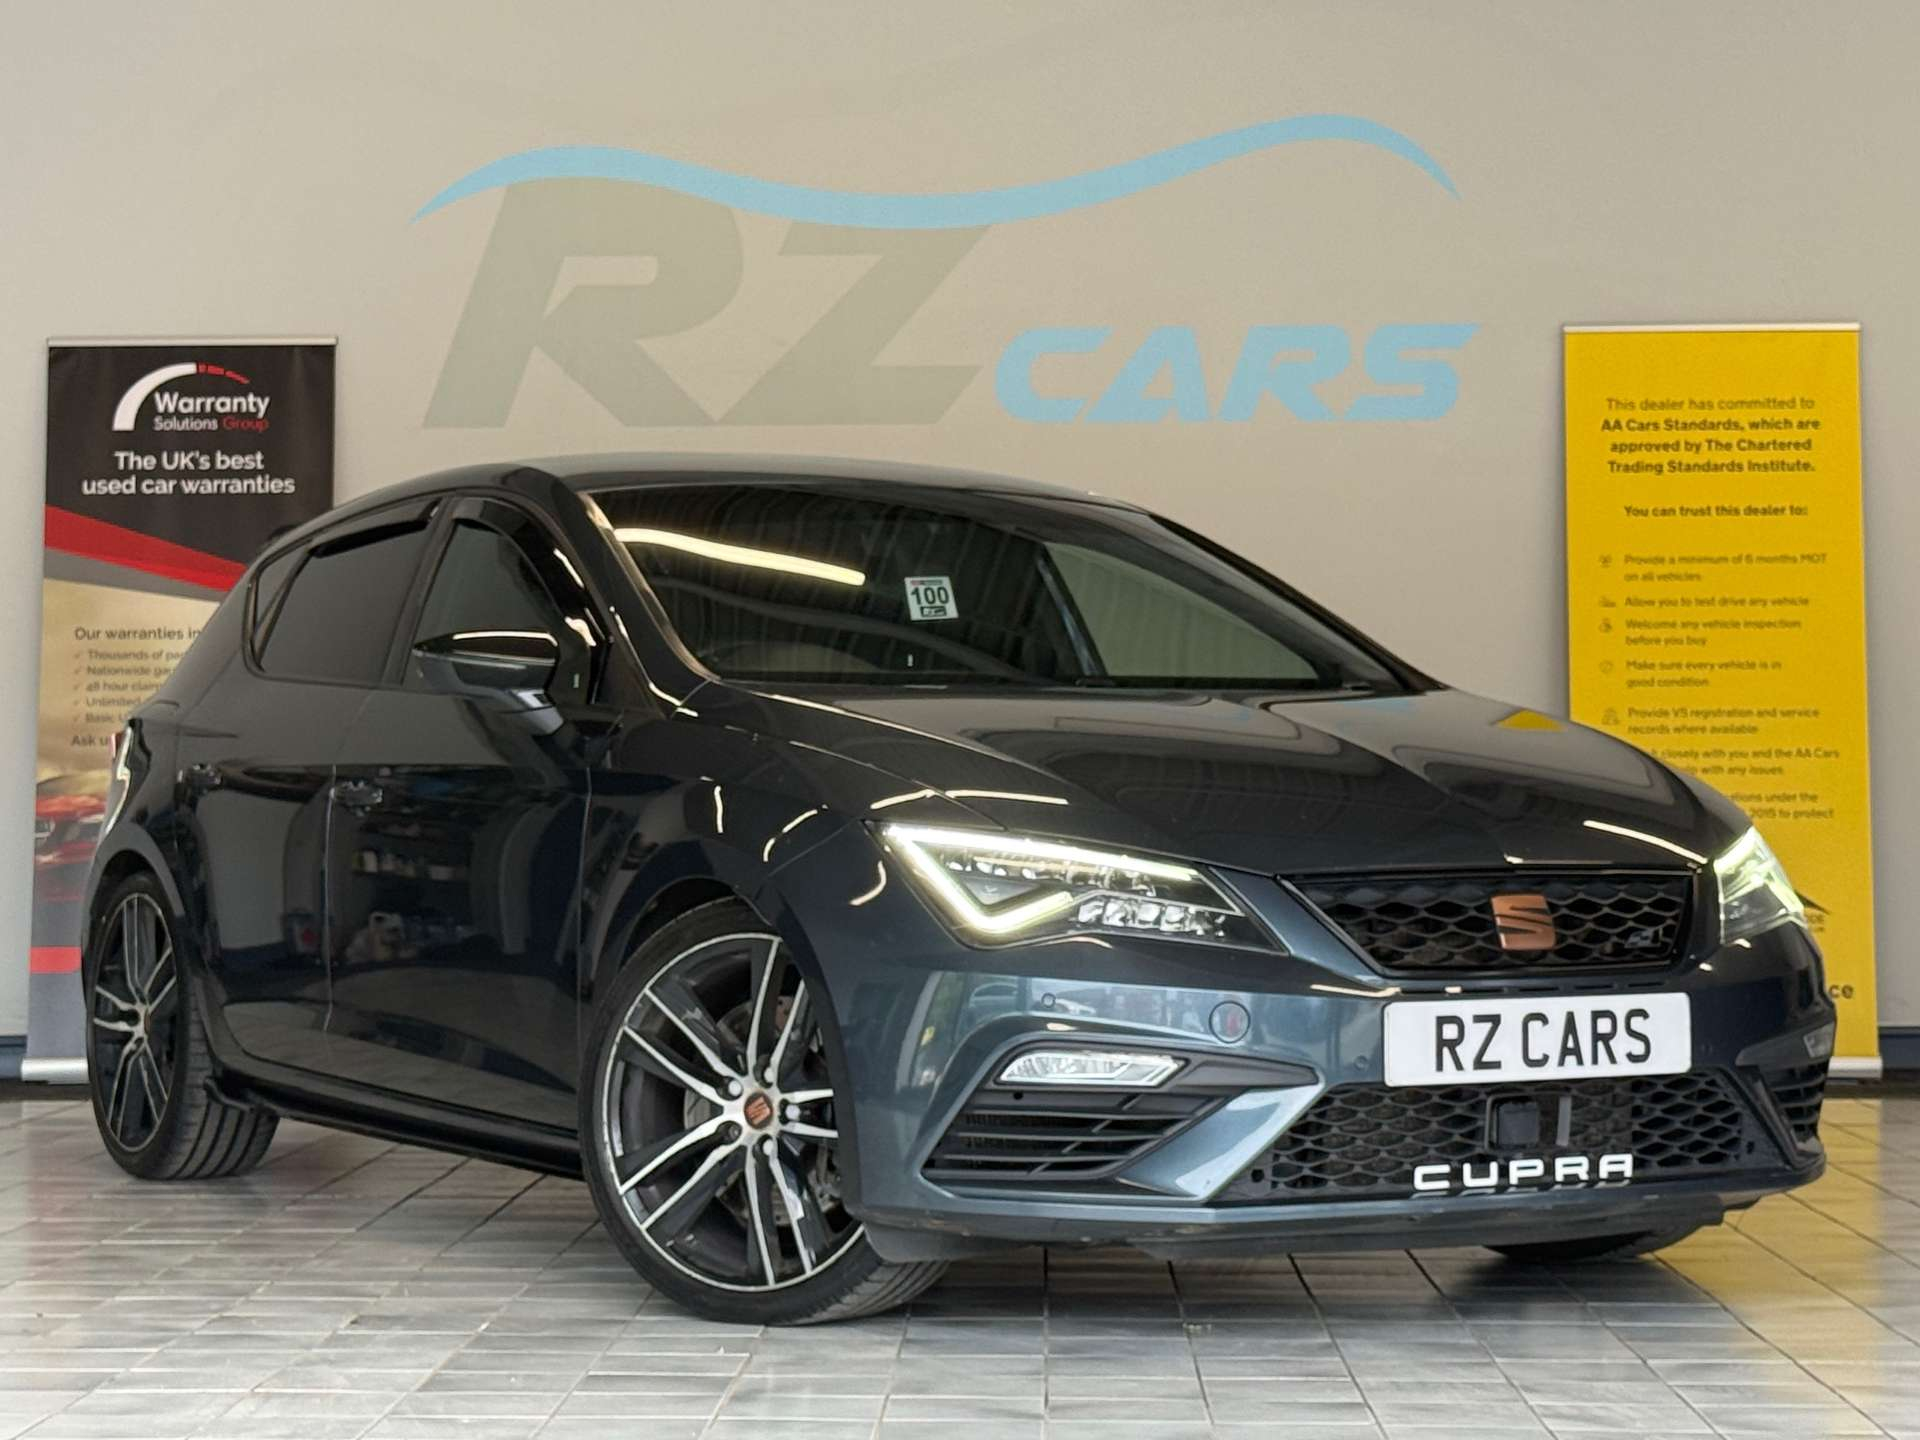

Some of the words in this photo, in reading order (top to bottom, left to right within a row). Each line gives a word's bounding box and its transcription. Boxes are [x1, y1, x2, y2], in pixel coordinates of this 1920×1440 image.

[421, 177, 994, 429] RZ
[994, 322, 1481, 424] CARS
[153, 391, 271, 418] Warranty
[1606, 398, 1636, 411] This
[1640, 398, 1684, 411] dealer
[1688, 398, 1714, 410] has
[1717, 398, 1796, 410] committed
[1800, 398, 1815, 410] to
[153, 415, 218, 431] Solutions
[222, 416, 269, 432] Group
[1601, 419, 1623, 432] AA
[1625, 418, 1660, 431] Cars
[1664, 418, 1744, 431] Standards,
[1747, 418, 1793, 430] which
[1796, 419, 1821, 430] are
[1610, 440, 1679, 453] approved
[1684, 440, 1701, 454] by
[1704, 439, 1733, 451] The
[1736, 439, 1812, 451] Chartered
[114, 451, 157, 470] The
[161, 451, 211, 470] UK's
[215, 450, 264, 470] best
[1607, 460, 1663, 475] Trading
[1667, 459, 1744, 473] Standards
[1747, 459, 1815, 472] Institute.
[82, 474, 136, 495] used
[141, 478, 177, 495] car
[180, 474, 295, 495] warranties
[1624, 505, 1649, 517] You
[1651, 507, 1677, 517] can
[1679, 505, 1711, 516] trust
[1715, 505, 1740, 516] this
[1743, 504, 1787, 516] dealer
[1789, 505, 1808, 516] to:
[1624, 554, 1665, 565] Provide
[1756, 554, 1797, 564] months
[1800, 553, 1827, 564] MOT
[1657, 572, 1701, 582] vehicles
[911, 587, 949, 605] 100
[1625, 597, 1656, 607] Allow
[1658, 598, 1678, 608] you
[1680, 597, 1692, 606] to
[1718, 596, 1745, 606] drive
[1770, 596, 1809, 606] vehicle
[1625, 618, 1677, 629] Welcome
[1702, 619, 1740, 629] vehicle
[1743, 619, 1801, 631] inspection
[74, 626, 101, 640] Our
[104, 626, 184, 640] warranties
[1625, 635, 1661, 645] before
[1664, 637, 1684, 647] you
[88, 649, 149, 660] Thousands
[152, 648, 164, 660] of
[86, 664, 151, 676] Nationwide
[1626, 660, 1655, 670] Make
[1659, 662, 1682, 670] sure
[1685, 662, 1715, 672] every
[1718, 660, 1755, 670] vehicle
[1626, 677, 1655, 688] good
[1657, 677, 1709, 687] condition
[1627, 708, 1669, 718] Provide
[1690, 707, 1753, 720] registration
[1756, 707, 1777, 718] and
[1780, 708, 1820, 718] service
[1627, 724, 1669, 734] records
[1673, 724, 1707, 734] where
[1709, 723, 1759, 734] available
[1702, 748, 1725, 759] with
[1729, 751, 1749, 760] you
[1752, 748, 1772, 758] and
[1775, 748, 1793, 758] the
[1814, 748, 1840, 759] Cars
[1701, 765, 1724, 774] with
[1727, 766, 1746, 776] any
[1765, 792, 1796, 802] under
[1800, 792, 1818, 802] the
[1779, 808, 1790, 818] to
[1793, 808, 1834, 819] protect
[1435, 1013, 1502, 1072] RZ
[1521, 1008, 1651, 1068] CARS
[1413, 1153, 1634, 1191] CUPRA
